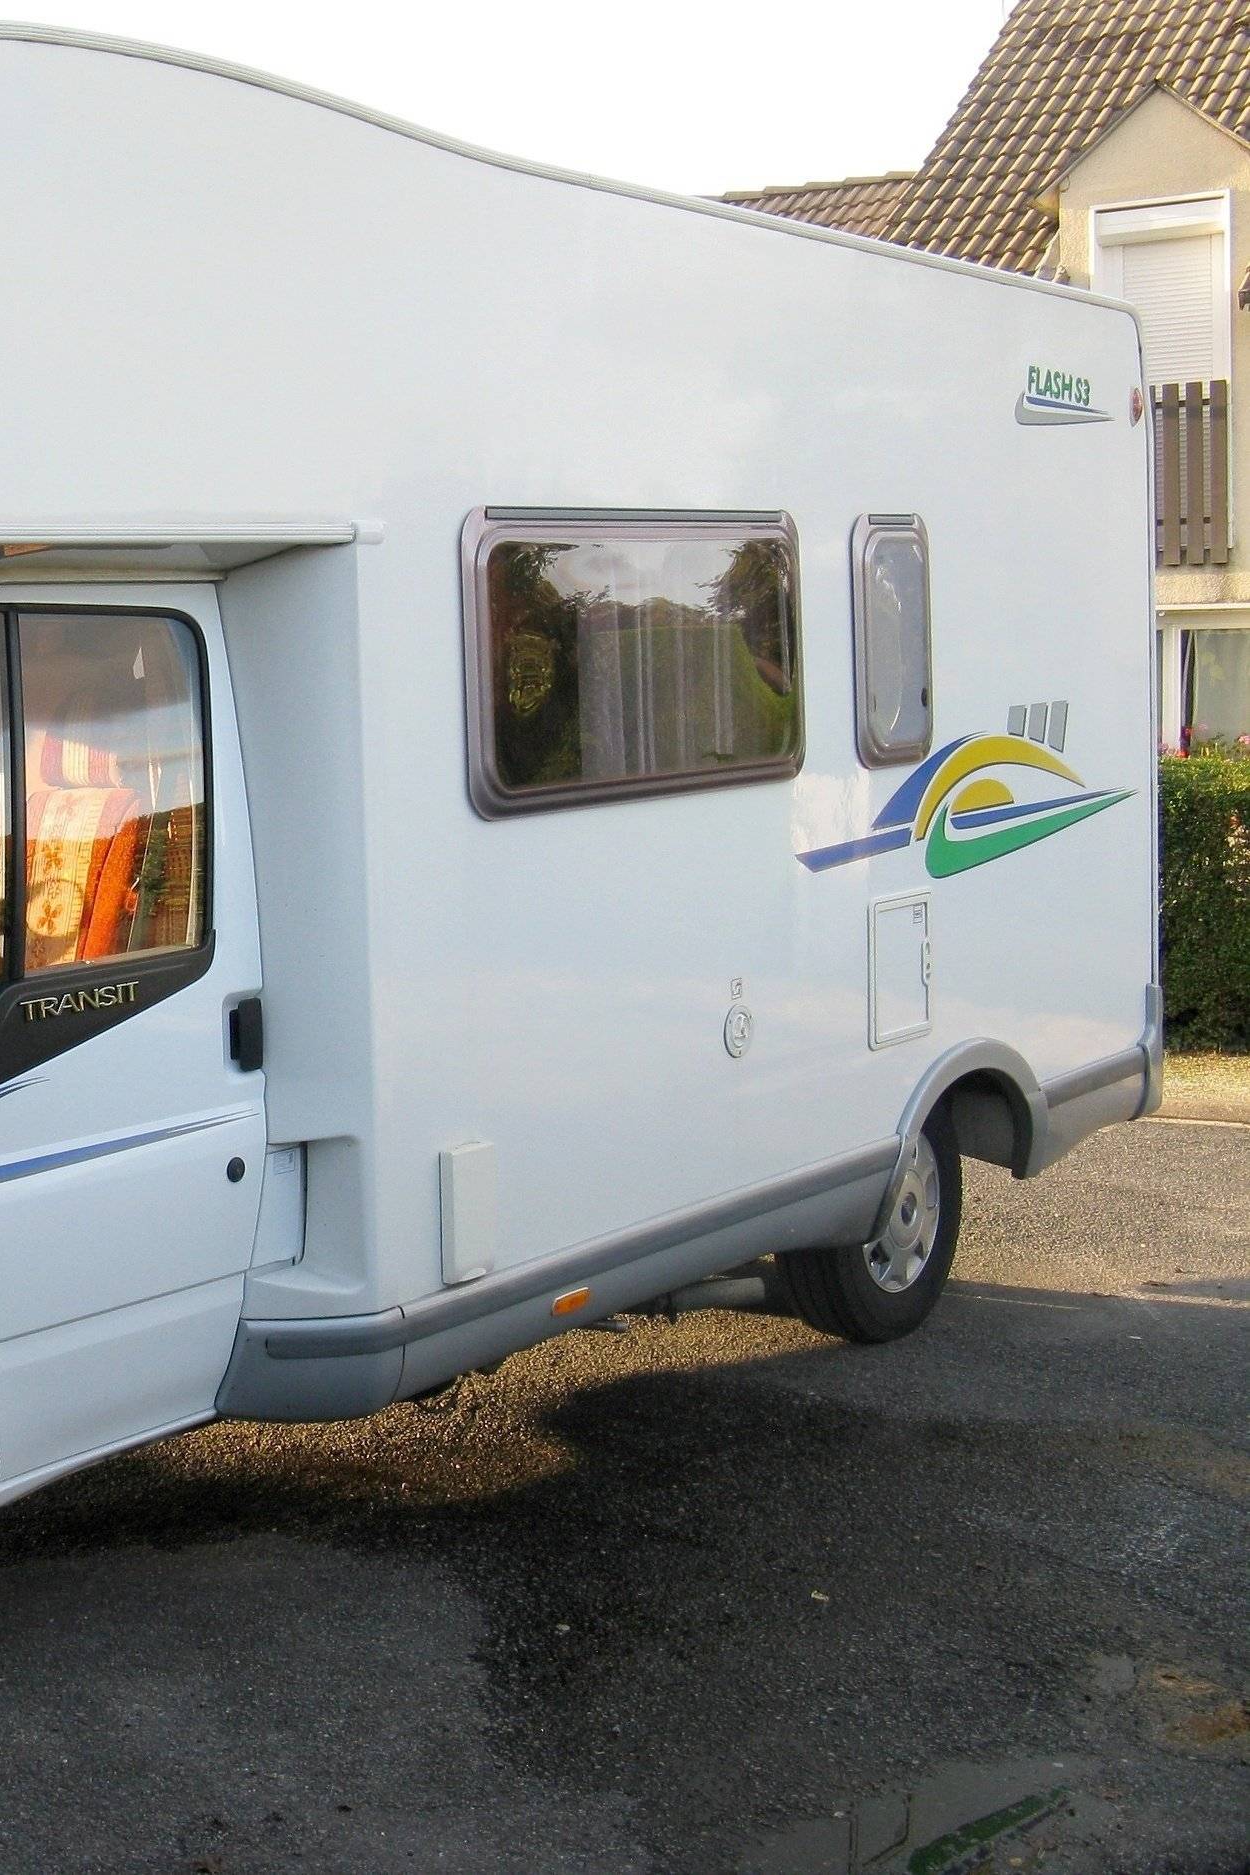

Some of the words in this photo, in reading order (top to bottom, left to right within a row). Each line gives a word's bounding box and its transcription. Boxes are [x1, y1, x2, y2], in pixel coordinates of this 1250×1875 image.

[1027, 365, 1073, 402] FLASH
[1074, 377, 1091, 406] S3
[19, 980, 140, 1021] TRANSIT
